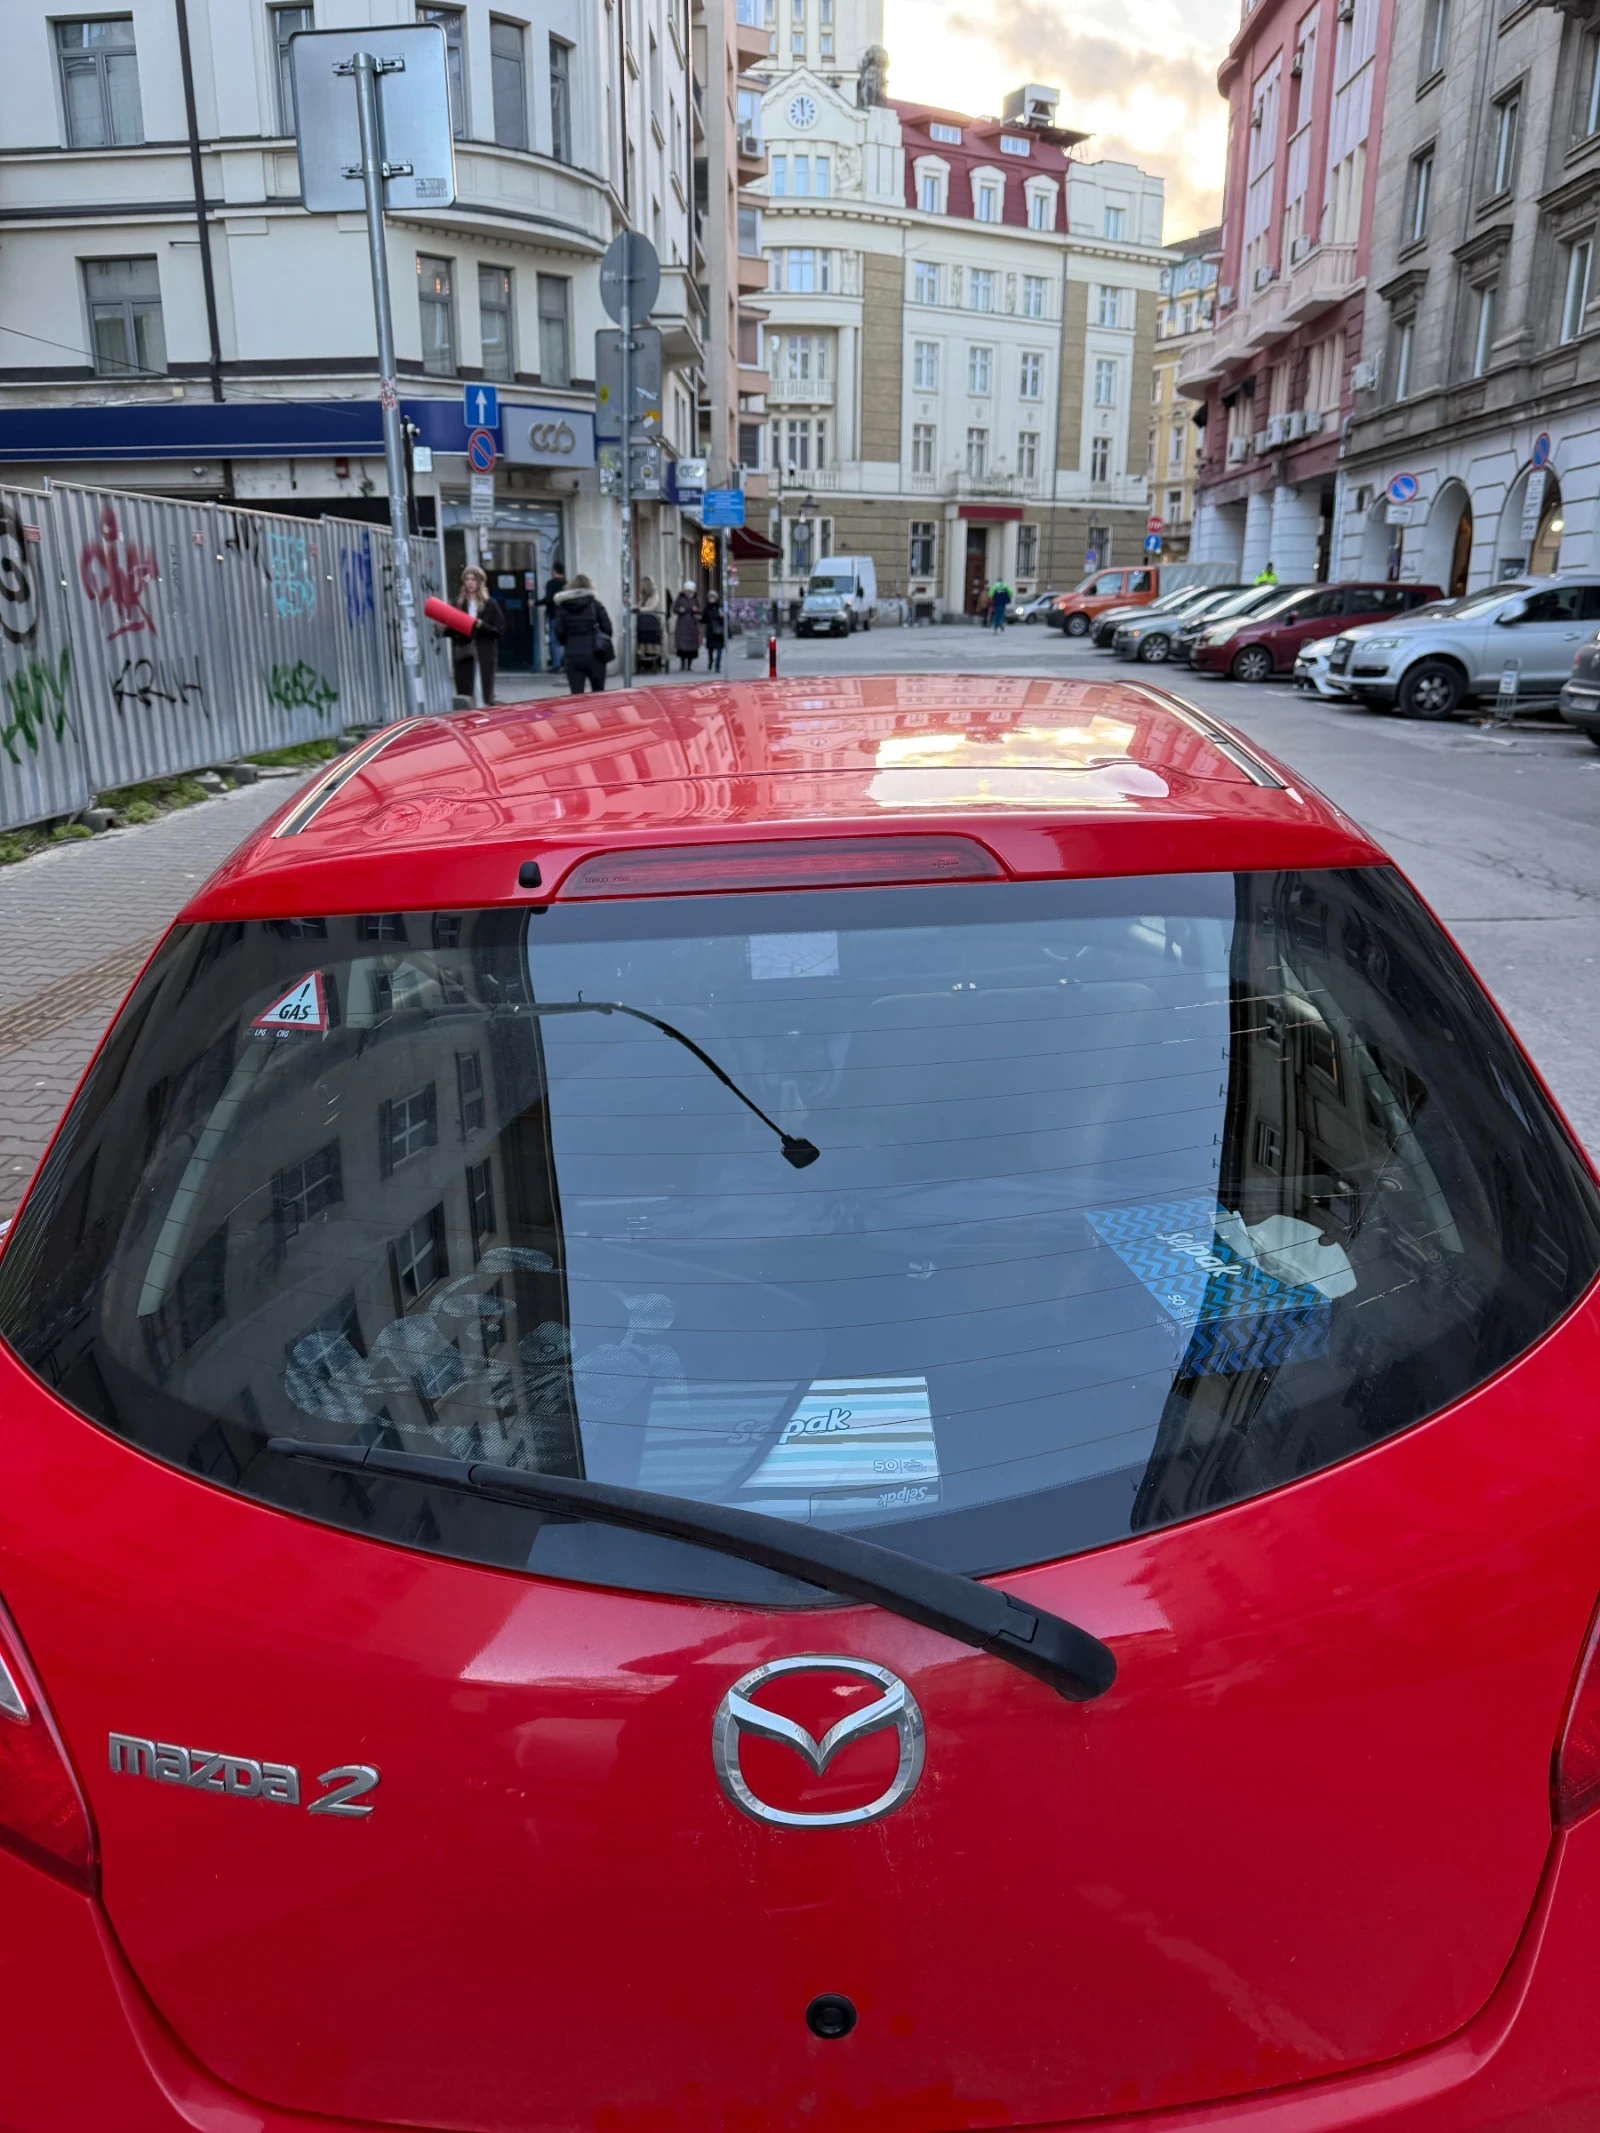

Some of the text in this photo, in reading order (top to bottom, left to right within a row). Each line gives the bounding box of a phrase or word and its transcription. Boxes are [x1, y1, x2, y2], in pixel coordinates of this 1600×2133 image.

[278, 1004, 311, 1020] GAS
[254, 1028, 290, 1038] LPG CNG
[1156, 1232, 1243, 1278] Selpak
[1167, 1294, 1186, 1306] 50
[726, 1407, 852, 1446] Sepak
[873, 1459, 899, 1473] 50
[877, 1486, 929, 1508] Selpak
[307, 1763, 381, 1818] 2
